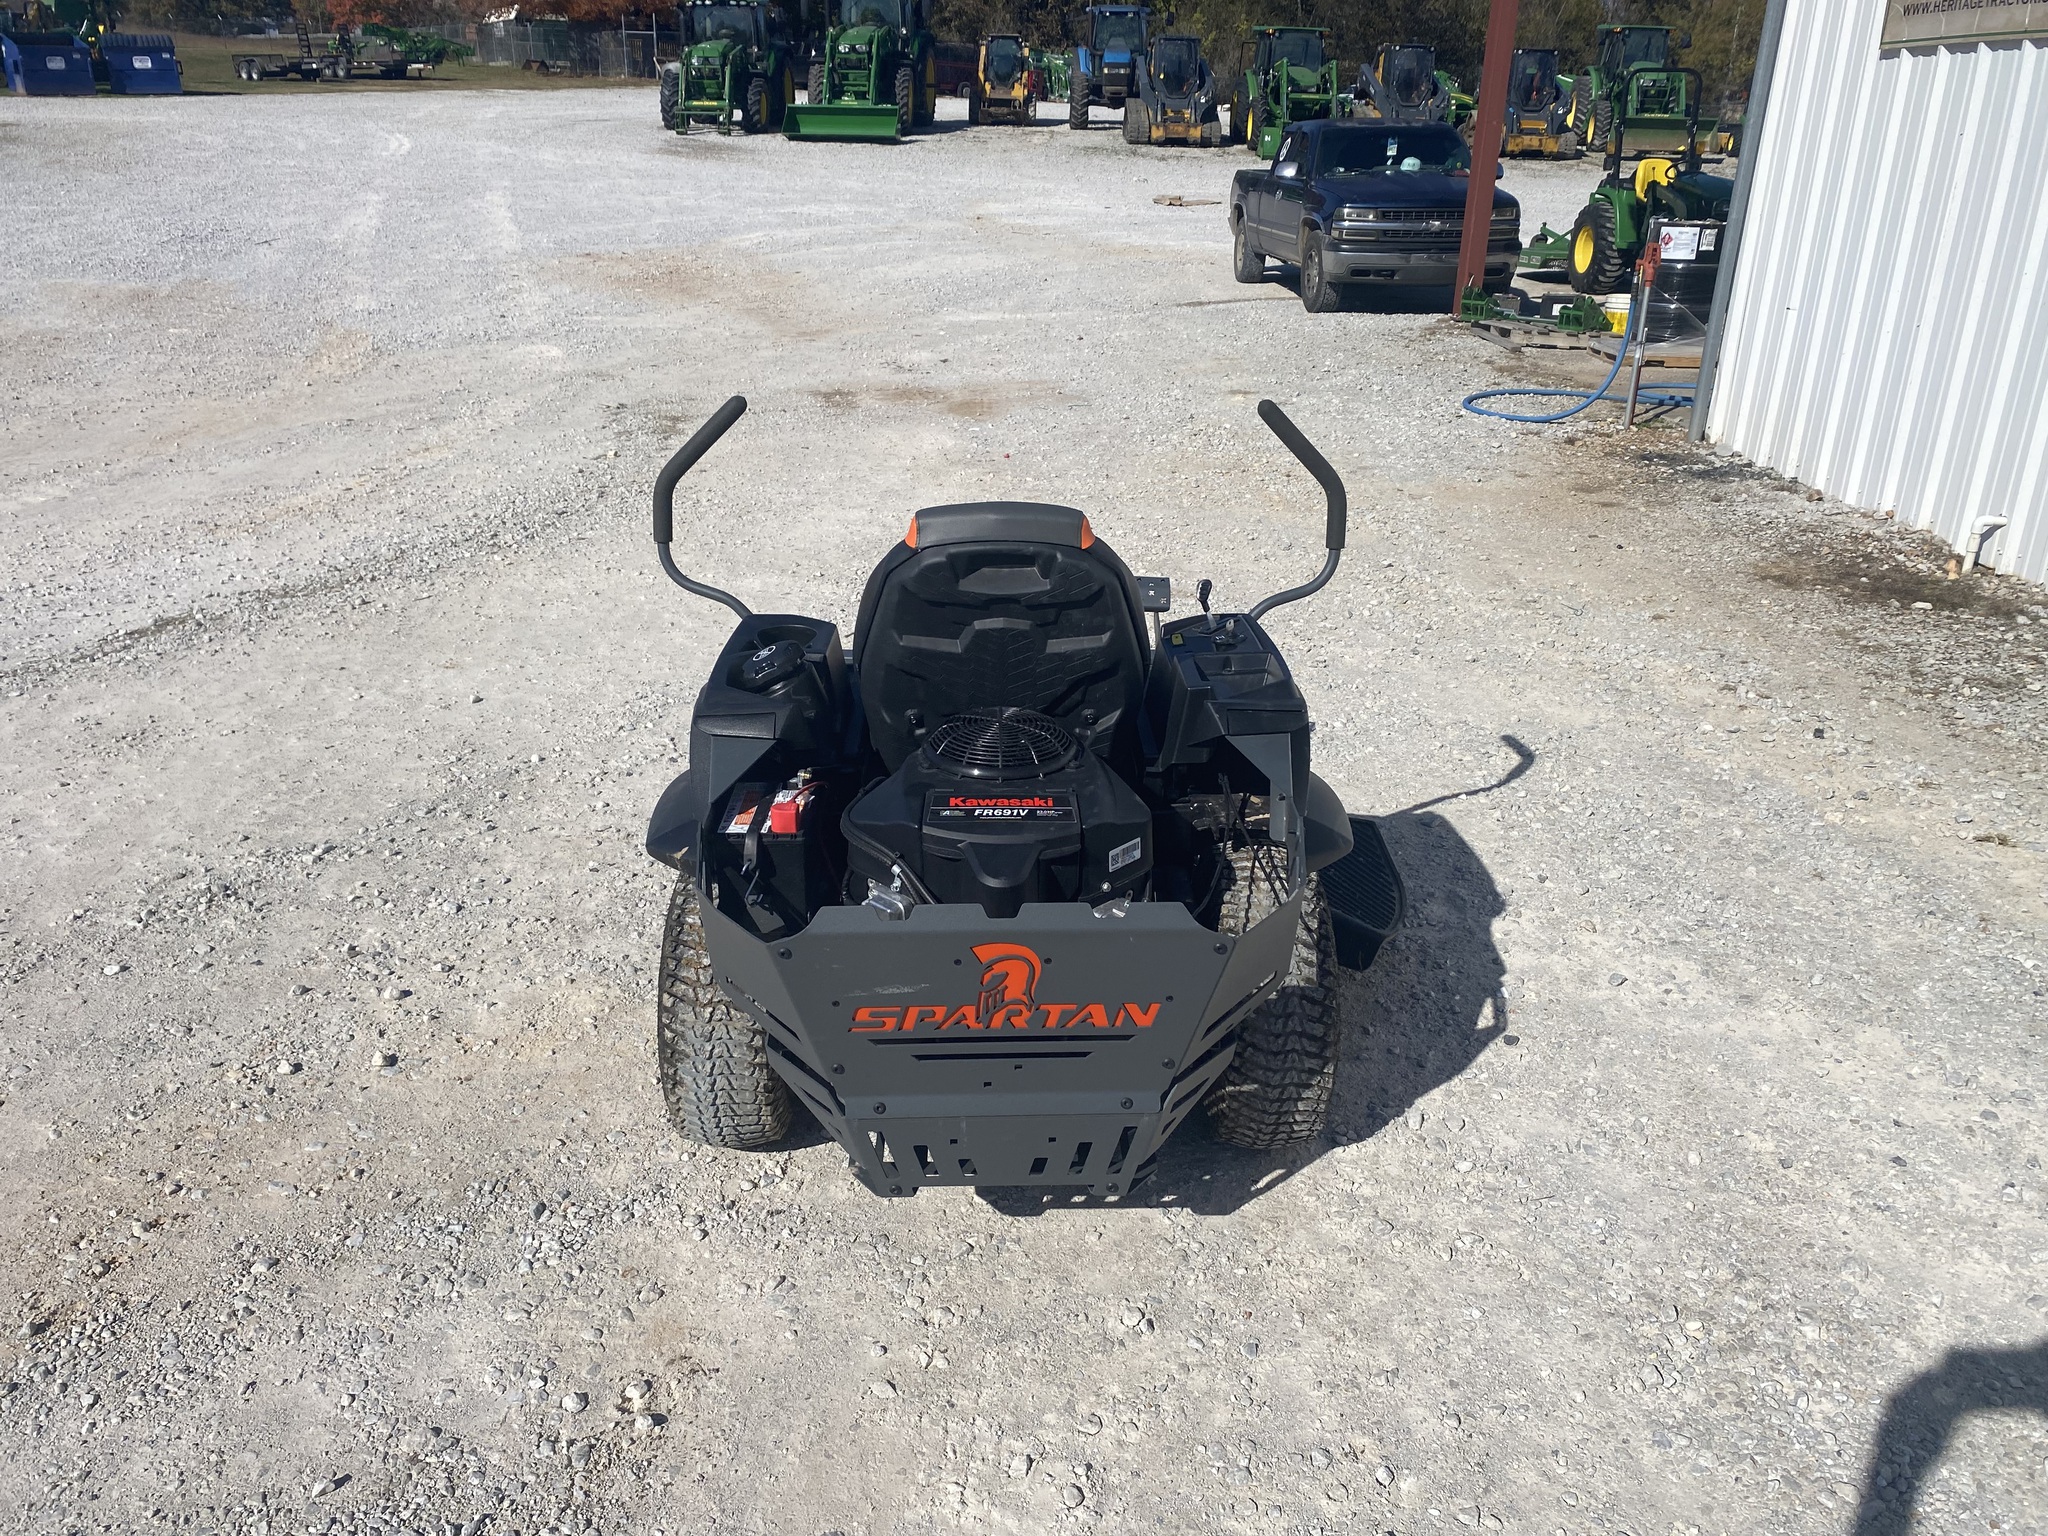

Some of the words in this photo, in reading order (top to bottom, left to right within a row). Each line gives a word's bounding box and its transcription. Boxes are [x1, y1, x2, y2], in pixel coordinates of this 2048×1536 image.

[949, 797, 1054, 807] Kawasaki
[973, 808, 1029, 817] FR691V
[848, 1003, 1162, 1033] SPARTAN
